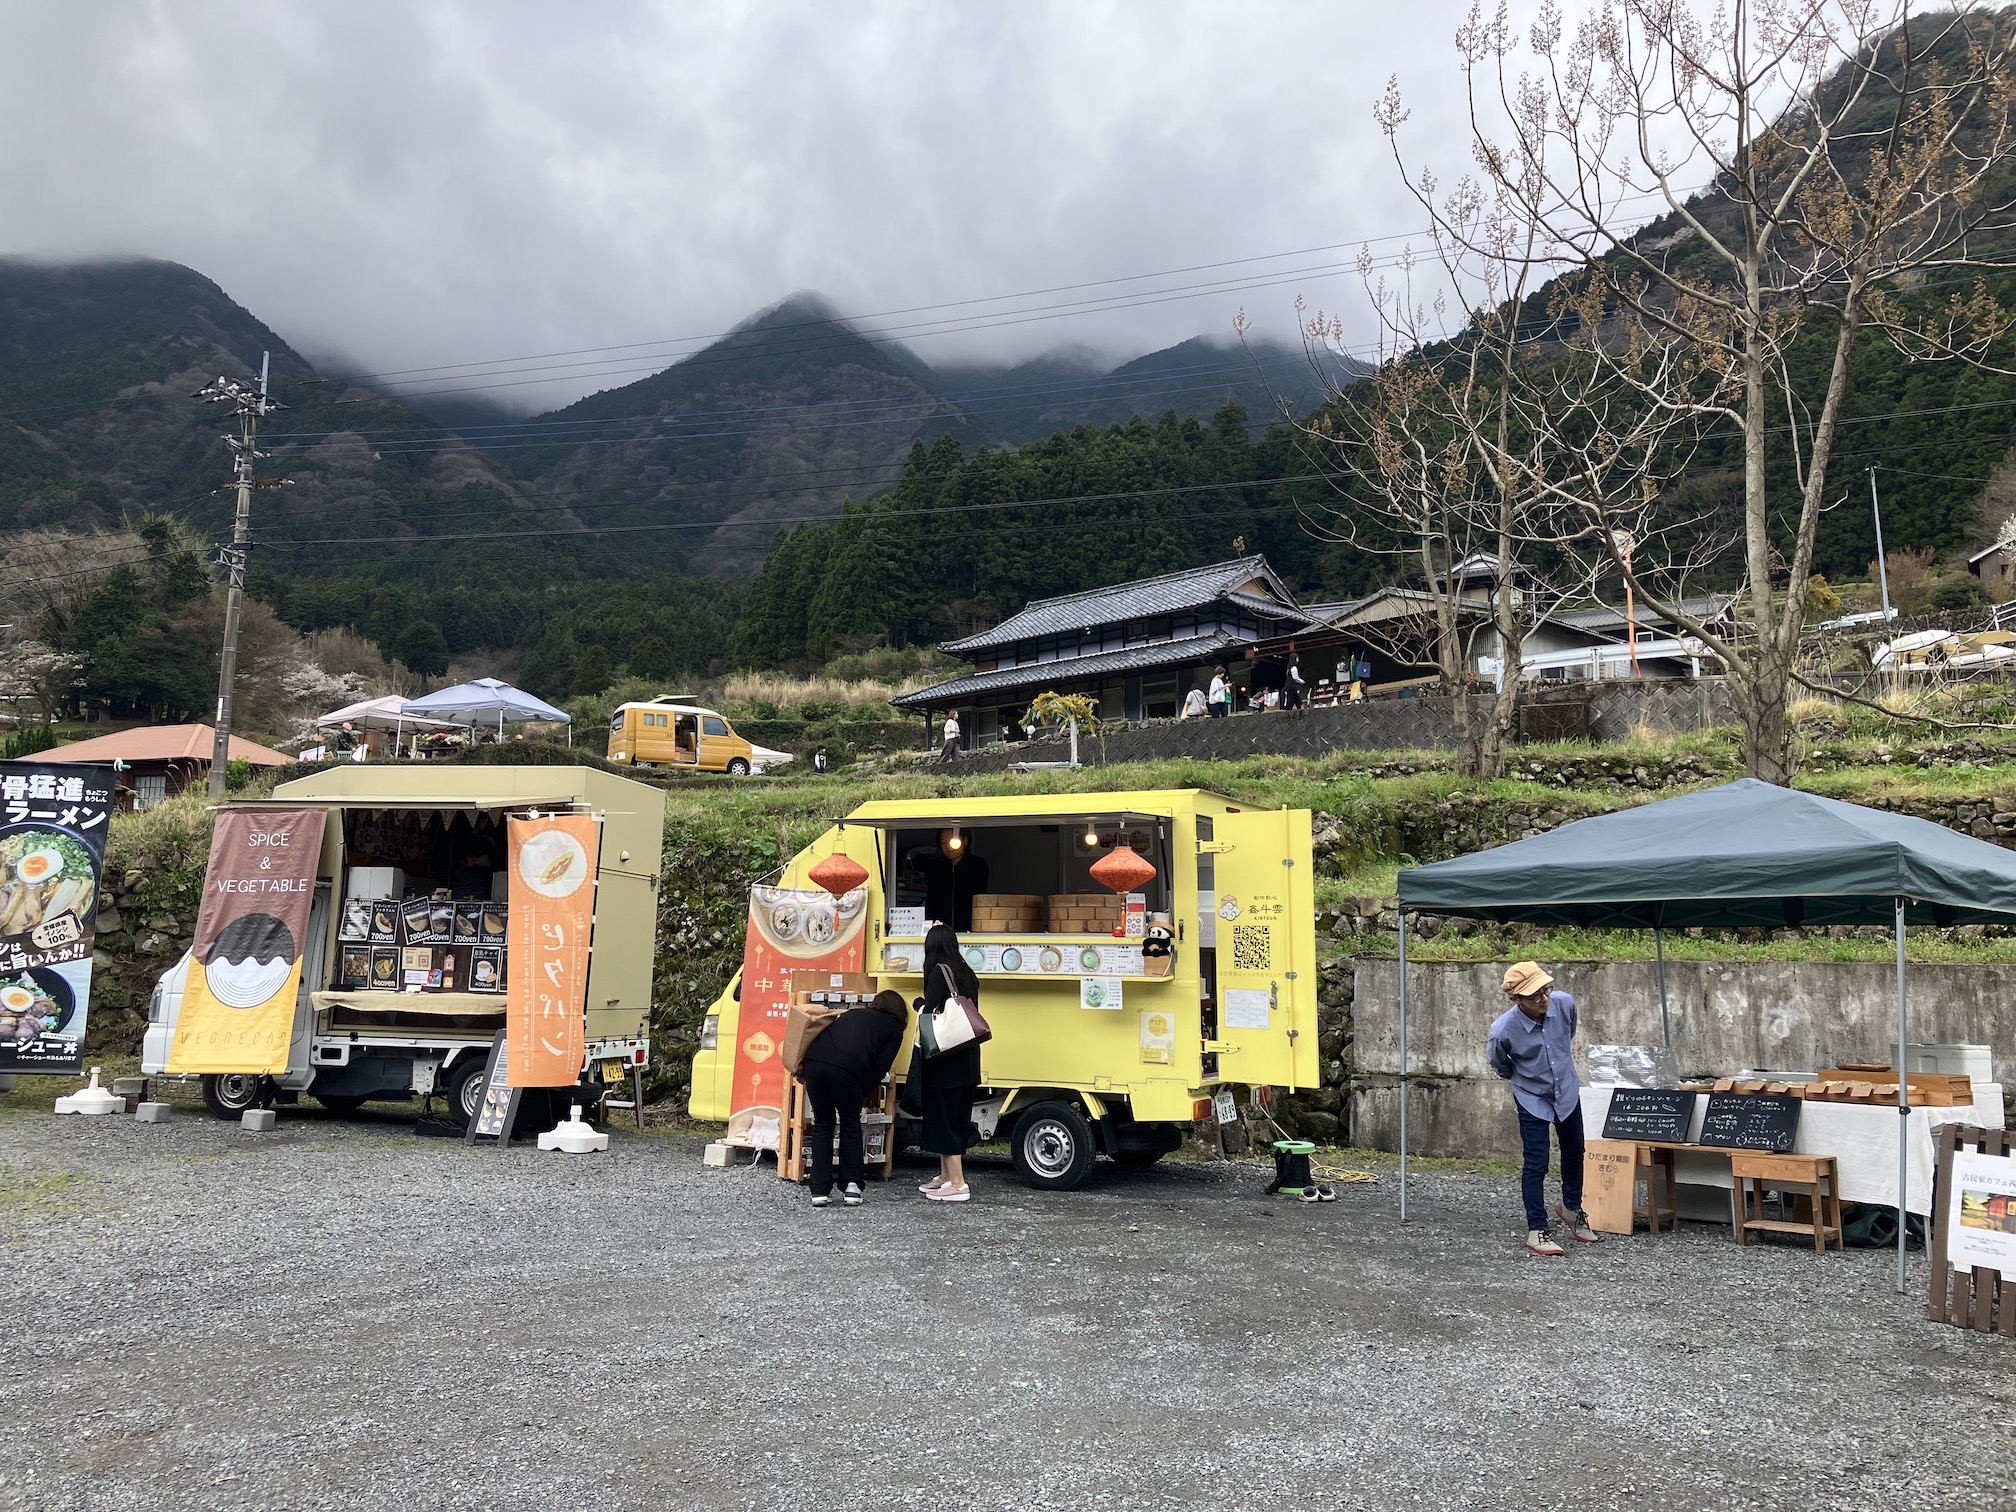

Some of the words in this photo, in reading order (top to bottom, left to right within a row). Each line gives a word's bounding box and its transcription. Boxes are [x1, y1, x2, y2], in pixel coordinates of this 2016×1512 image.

[0, 774, 84, 802] 骨猛進
[5, 800, 107, 831] ラーメン
[248, 833, 290, 847] SPICE
[260, 856, 271, 870] &
[217, 878, 308, 893] VEGETABLE
[45, 926, 69, 937] イノシシ
[371, 932, 394, 941] 700yen
[408, 930, 431, 941] 700yen
[48, 934, 72, 944] 100%
[454, 935, 477, 943] 700yen
[482, 935, 504, 943] 700yen
[372, 979, 395, 987] 400yen
[749, 1043, 770, 1052] 無添加
[1588, 1152, 1630, 1164] ひだまり農園
[1598, 1164, 1620, 1173] きむら
